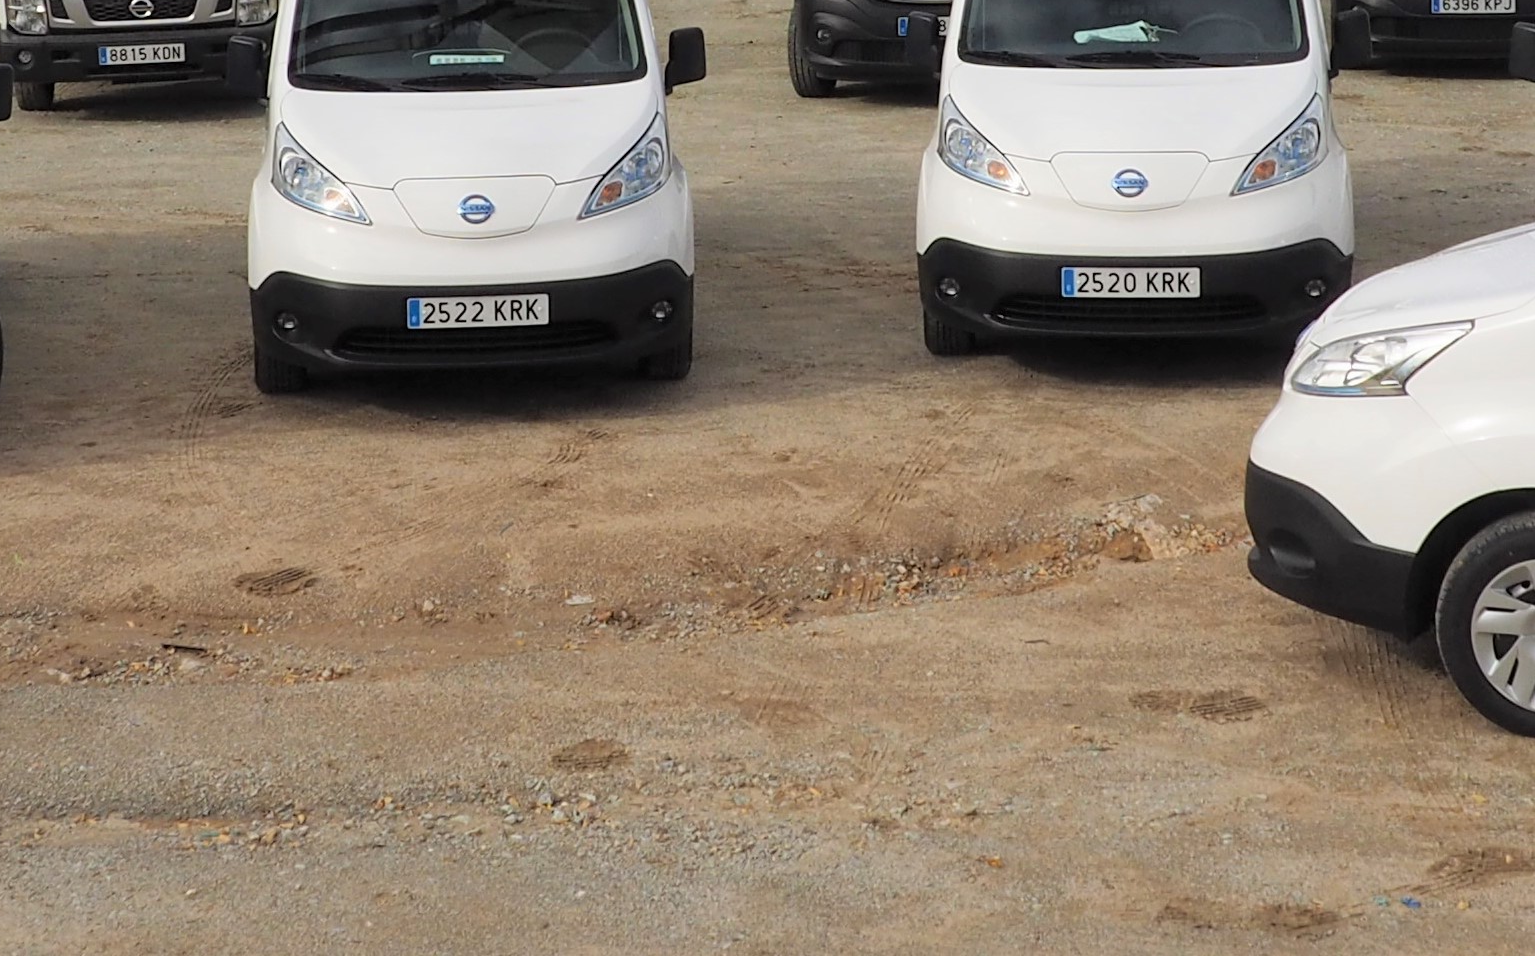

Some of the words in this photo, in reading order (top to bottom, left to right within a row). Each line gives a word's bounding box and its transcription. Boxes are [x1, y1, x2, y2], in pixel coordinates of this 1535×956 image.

[109, 47, 148, 62] 8815
[153, 46, 181, 60] KDN
[1077, 272, 1137, 293] 2520
[1146, 272, 1190, 293] KRK
[423, 301, 484, 324] 2522
[494, 299, 539, 321] KRK
